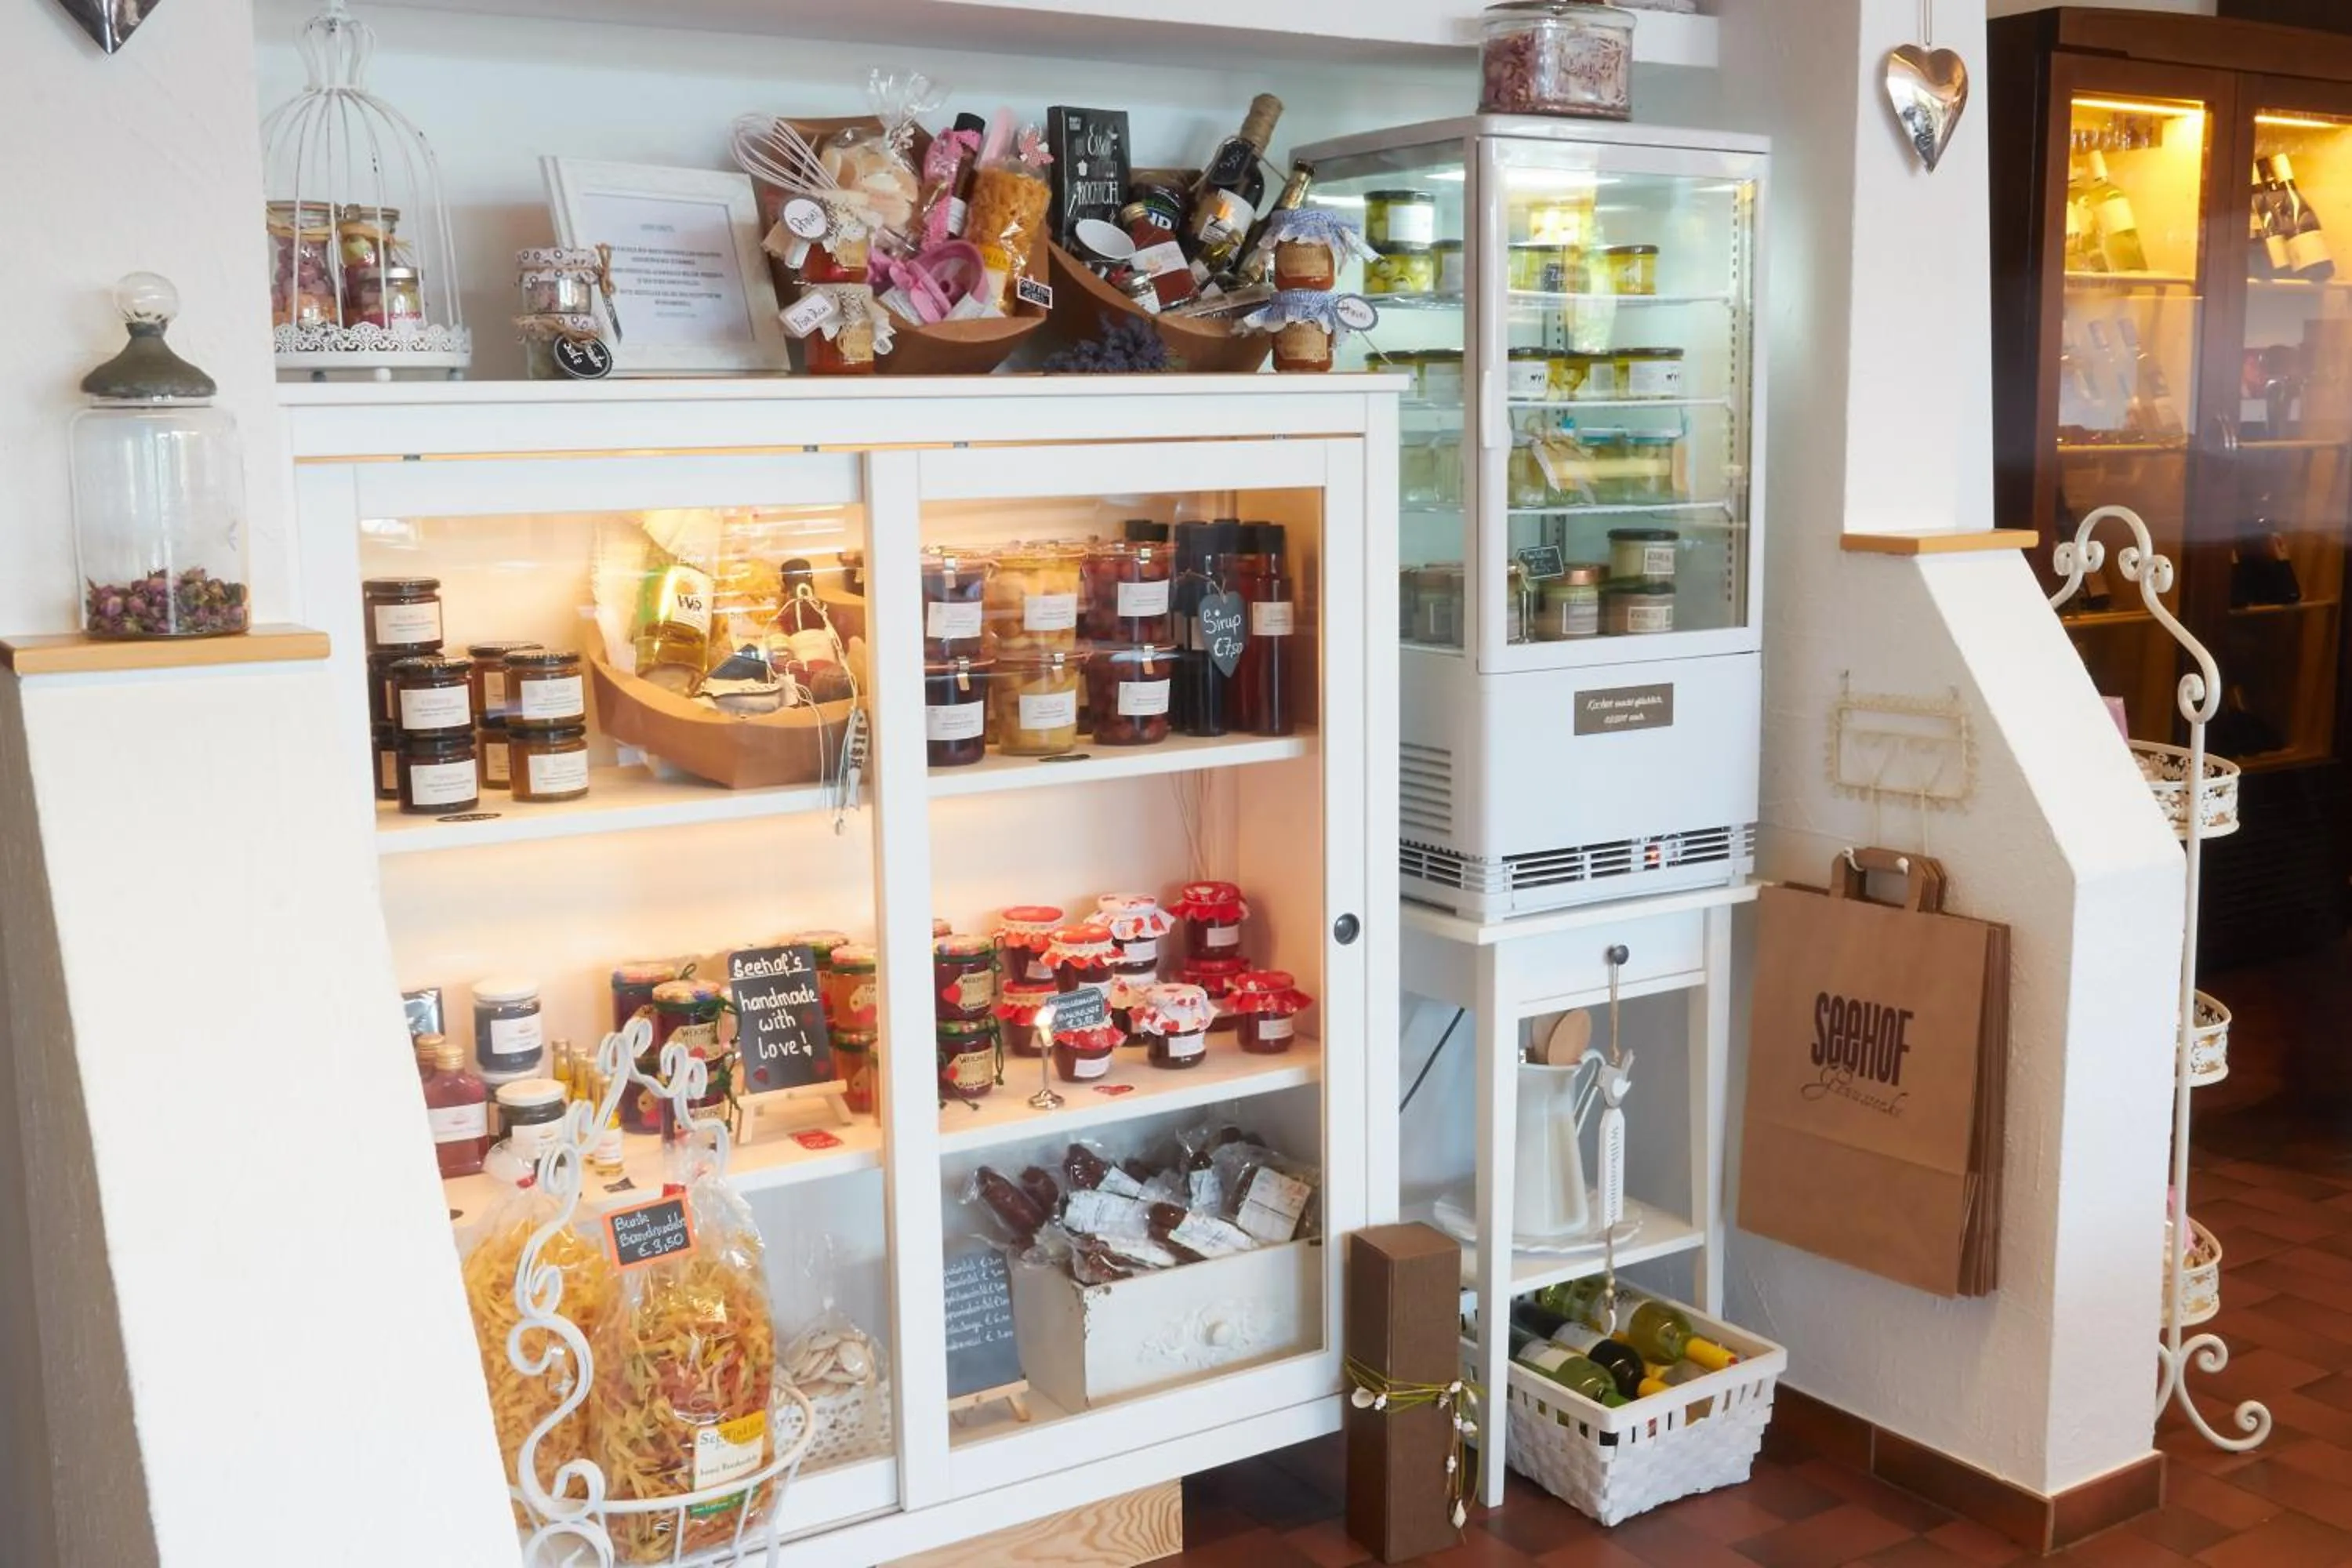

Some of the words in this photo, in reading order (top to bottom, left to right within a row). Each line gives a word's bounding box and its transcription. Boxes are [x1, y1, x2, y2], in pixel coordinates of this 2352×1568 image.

[1203, 608, 1241, 636] Sirup
[734, 949, 803, 978] Seehof's
[739, 984, 819, 1011] handmade
[759, 1010, 796, 1033] with
[615, 1211, 650, 1231] Bunte
